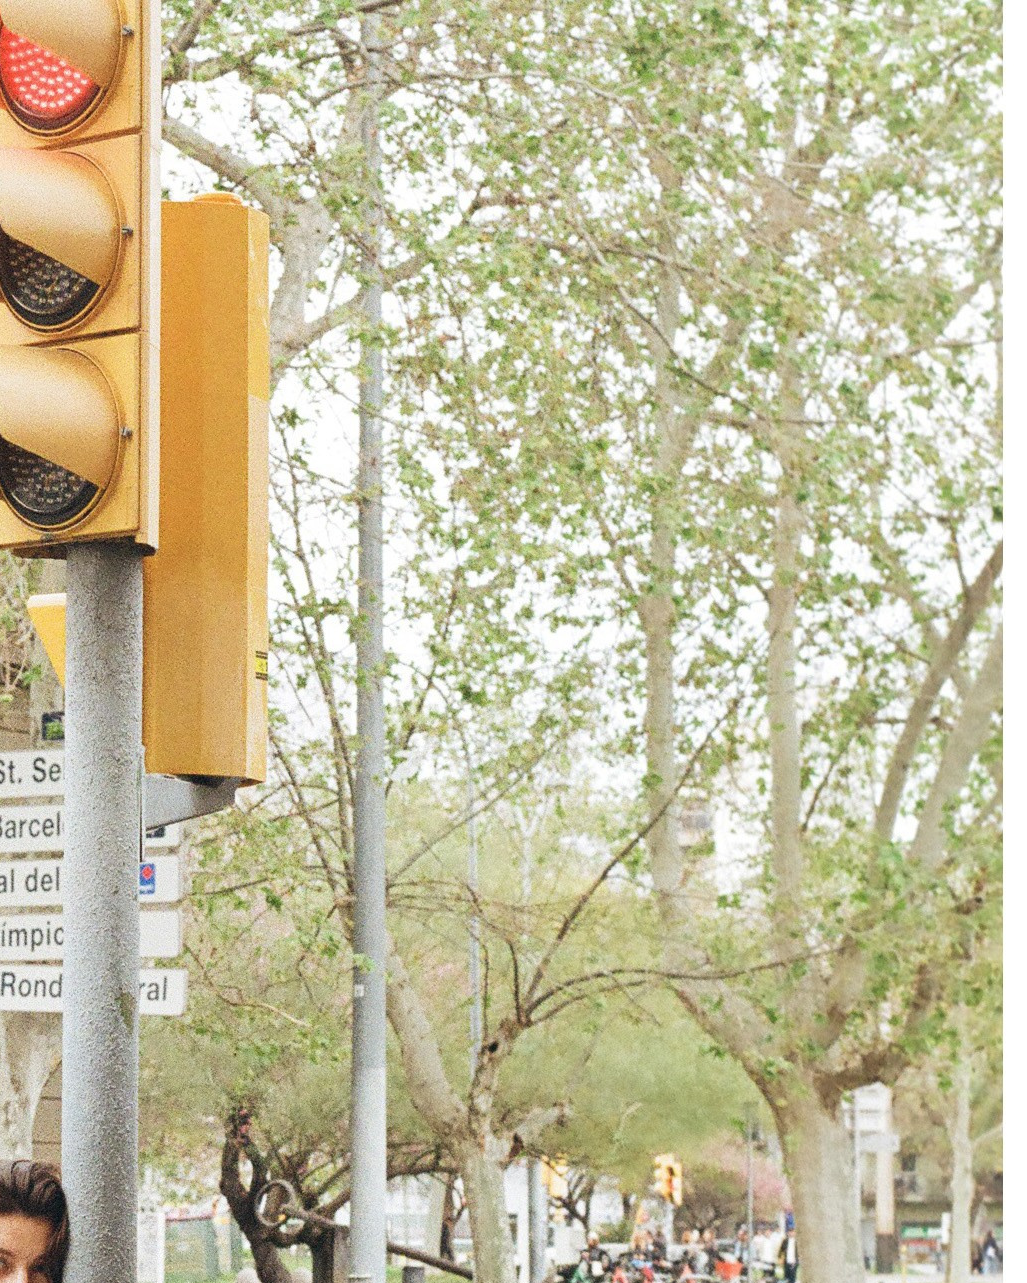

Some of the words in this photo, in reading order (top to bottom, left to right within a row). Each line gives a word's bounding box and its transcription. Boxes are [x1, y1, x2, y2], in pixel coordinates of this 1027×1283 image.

[32, 757, 65, 782] Se
[25, 866, 60, 893] del
[0, 971, 62, 997] Rond
